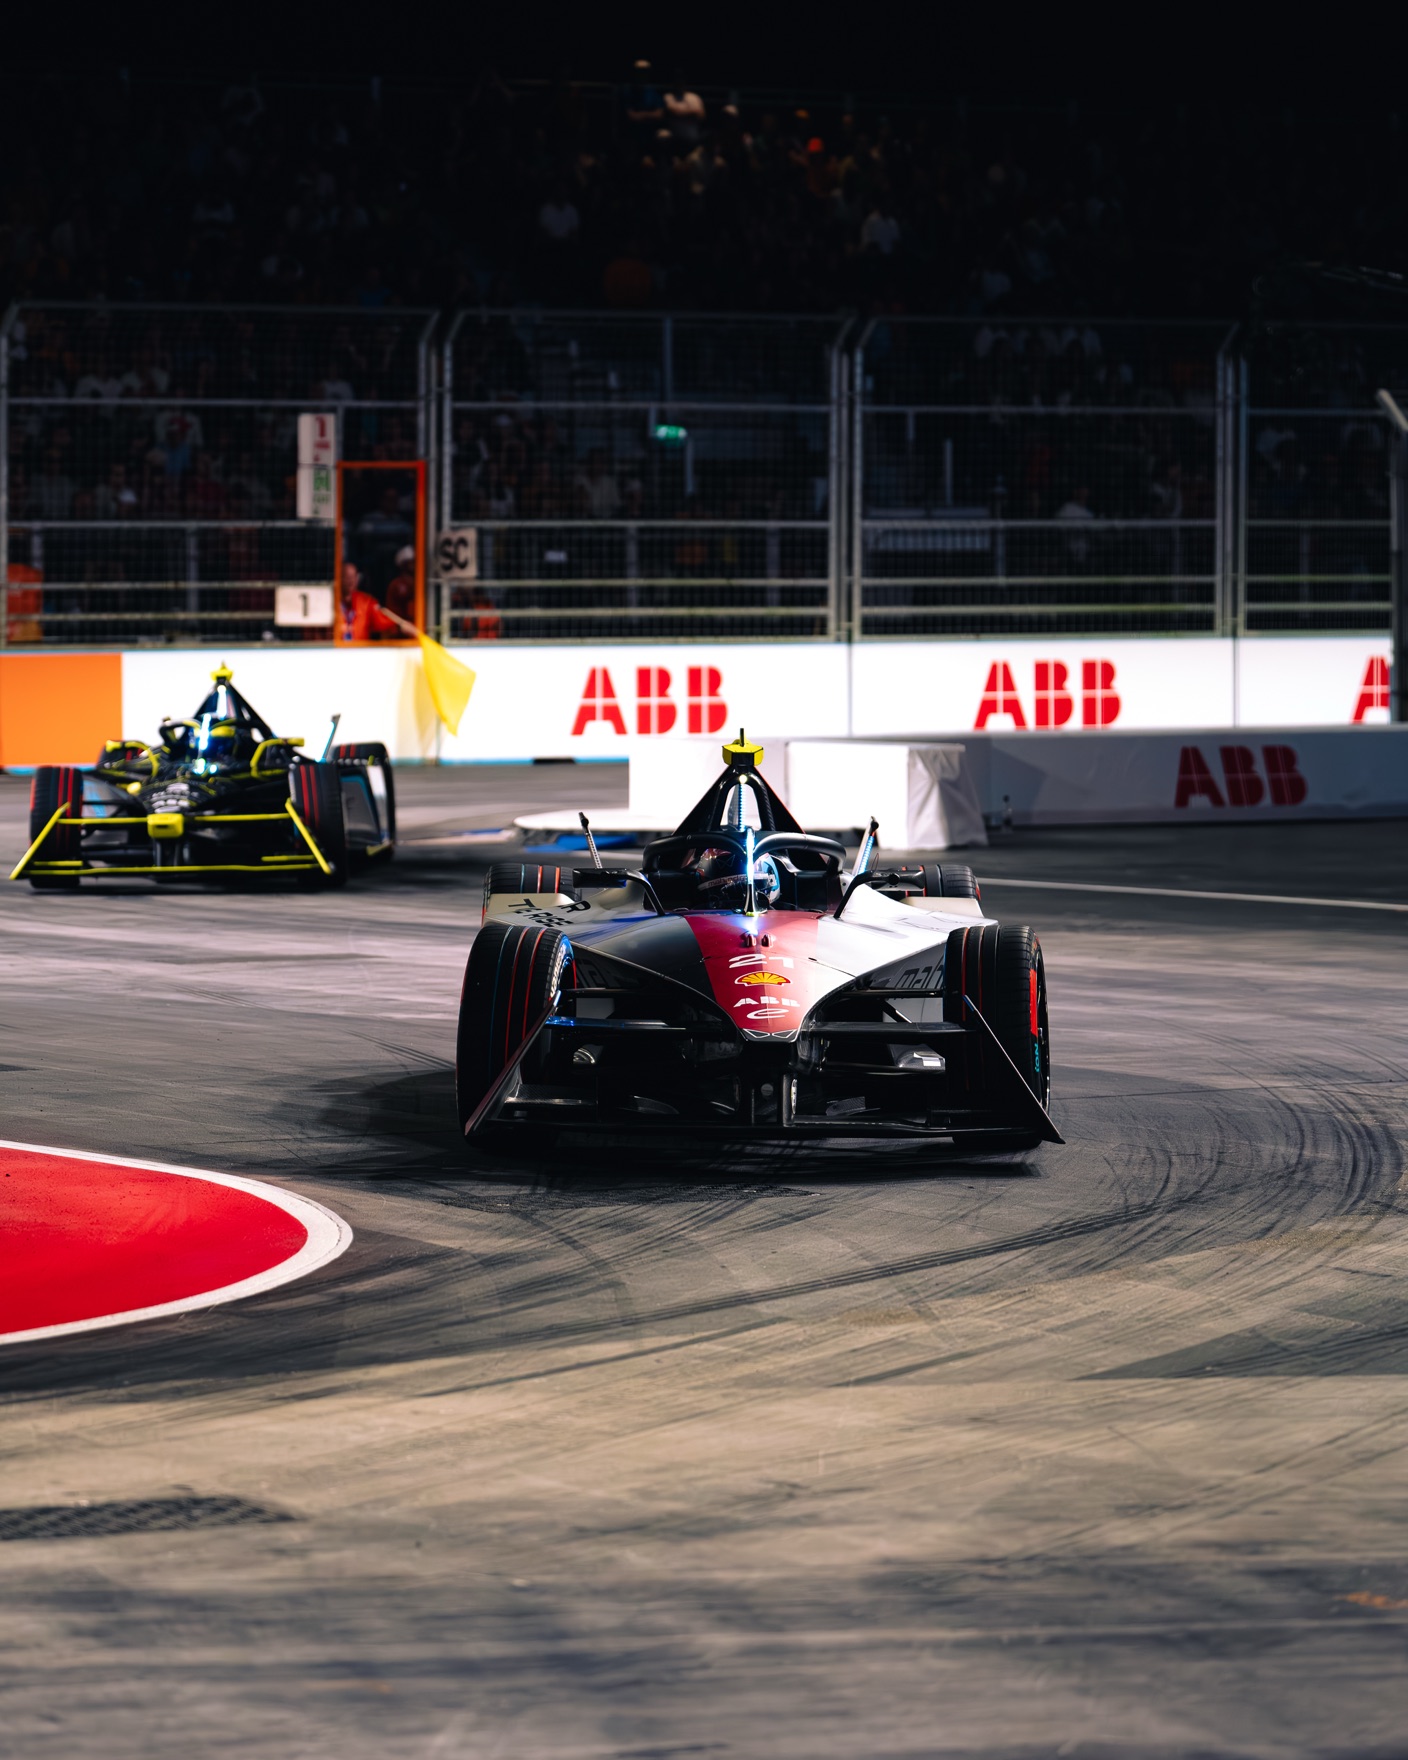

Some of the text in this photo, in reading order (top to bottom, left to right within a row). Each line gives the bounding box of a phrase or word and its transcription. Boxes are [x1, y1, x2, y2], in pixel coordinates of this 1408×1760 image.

[440, 536, 469, 572] SC
[299, 594, 309, 618] 1
[571, 666, 728, 735] ABB
[973, 661, 1121, 731] ABB
[1174, 745, 1309, 809] ABB
[728, 953, 795, 969] 21
[733, 996, 801, 1008] ABB
